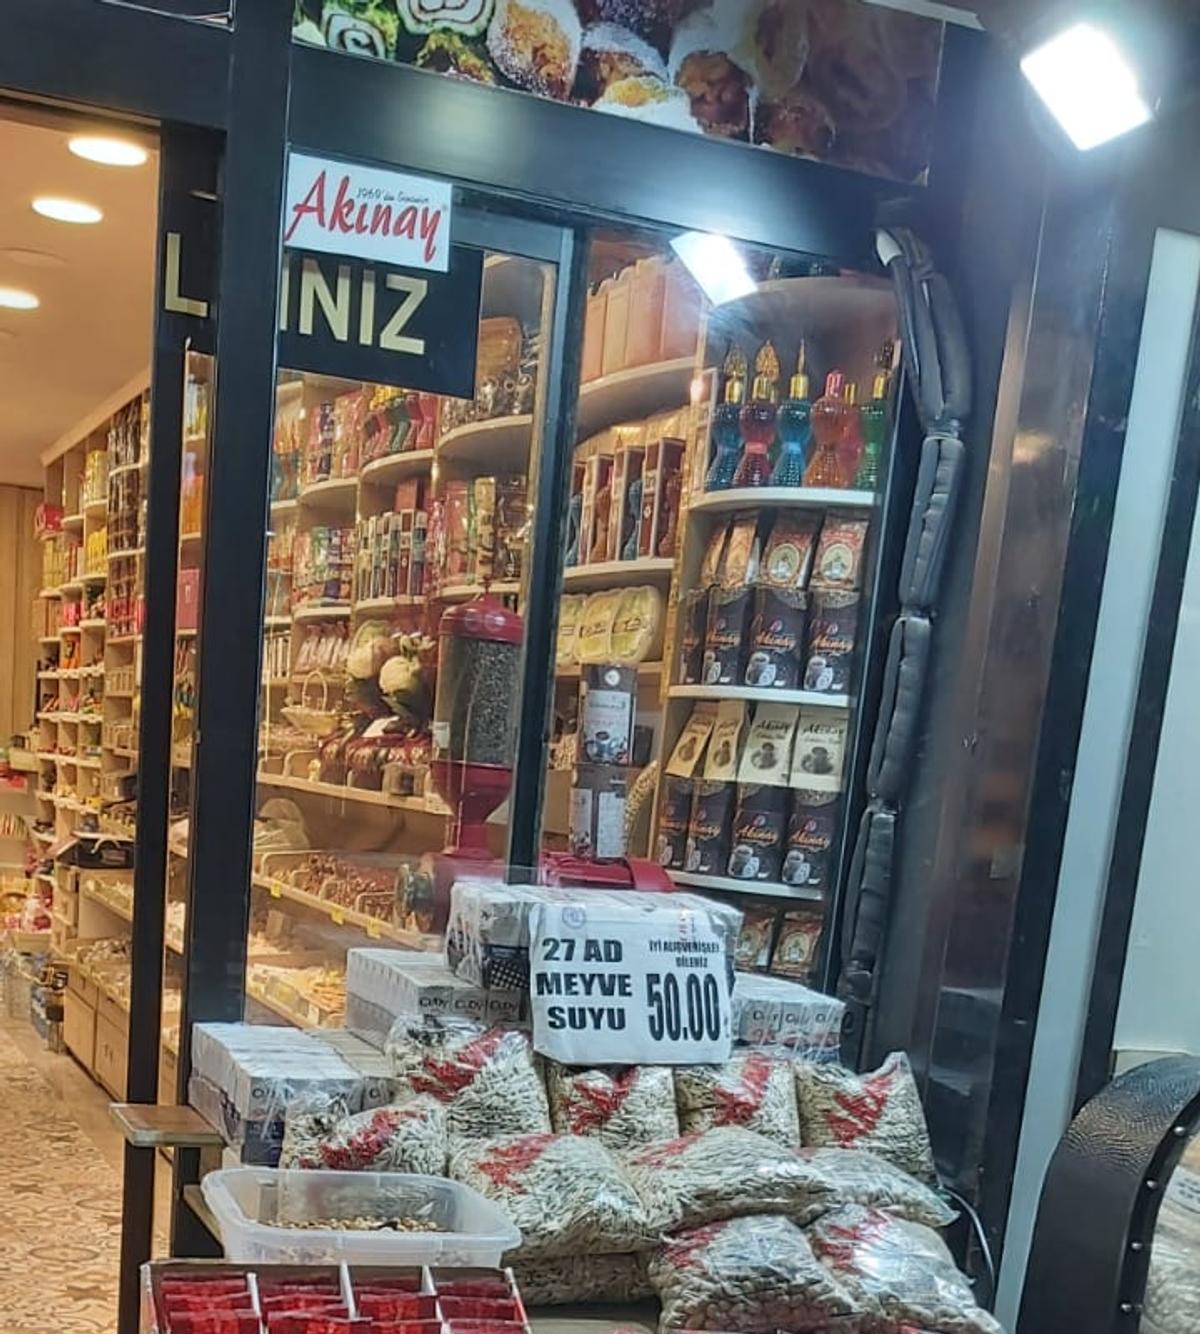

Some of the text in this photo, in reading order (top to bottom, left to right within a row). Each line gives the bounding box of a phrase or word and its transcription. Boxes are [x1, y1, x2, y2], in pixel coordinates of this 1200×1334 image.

[285, 170, 441, 264] Akınay
[541, 937, 623, 963] 27 AD
[535, 972, 633, 997] MEYVE
[548, 1005, 626, 1031] SUYU
[646, 971, 721, 1042] 50.00
